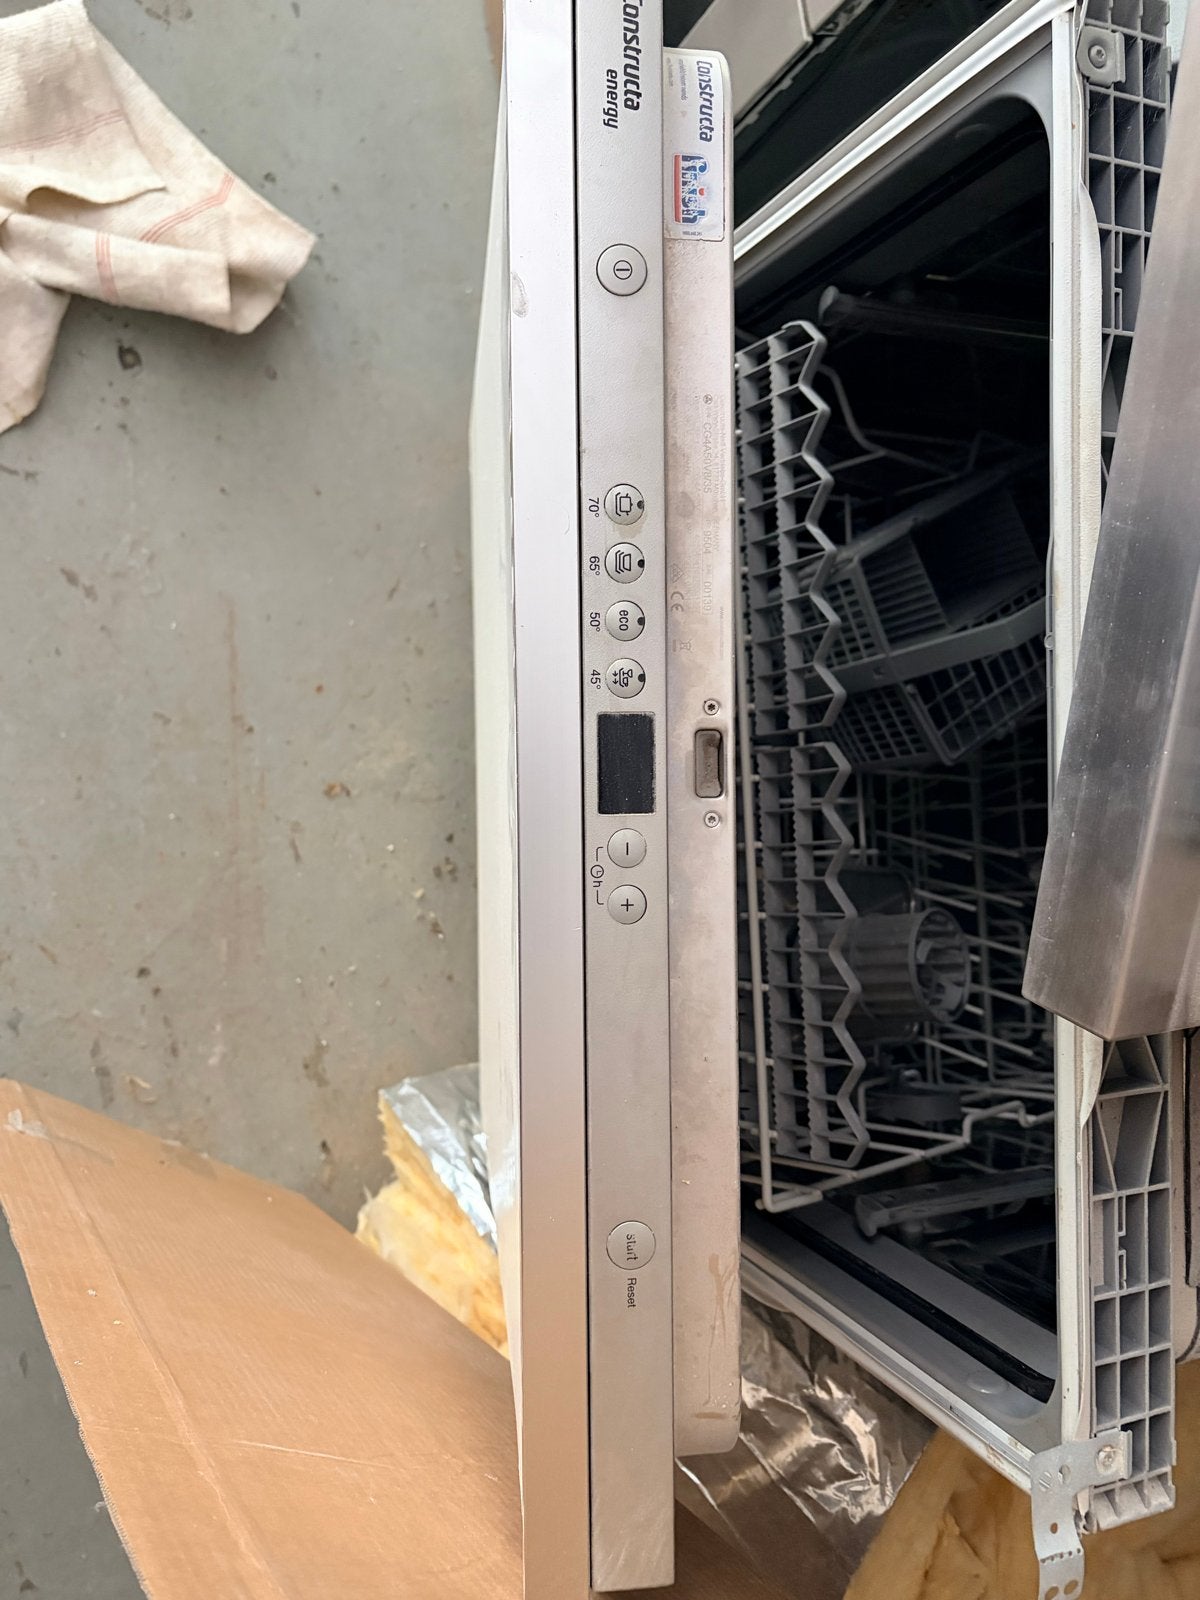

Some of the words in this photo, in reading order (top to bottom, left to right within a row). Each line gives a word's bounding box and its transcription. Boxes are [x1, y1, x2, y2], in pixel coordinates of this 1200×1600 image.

[602, 68, 619, 129] energy
[696, 60, 715, 143] Constructa
[588, 497, 600, 518] 70°
[703, 530, 712, 554] 9504
[589, 556, 601, 576] 65°
[589, 612, 601, 632] 50°
[618, 609, 629, 632] eco
[590, 669, 601, 690] 45°
[626, 1277, 638, 1308] Reset
